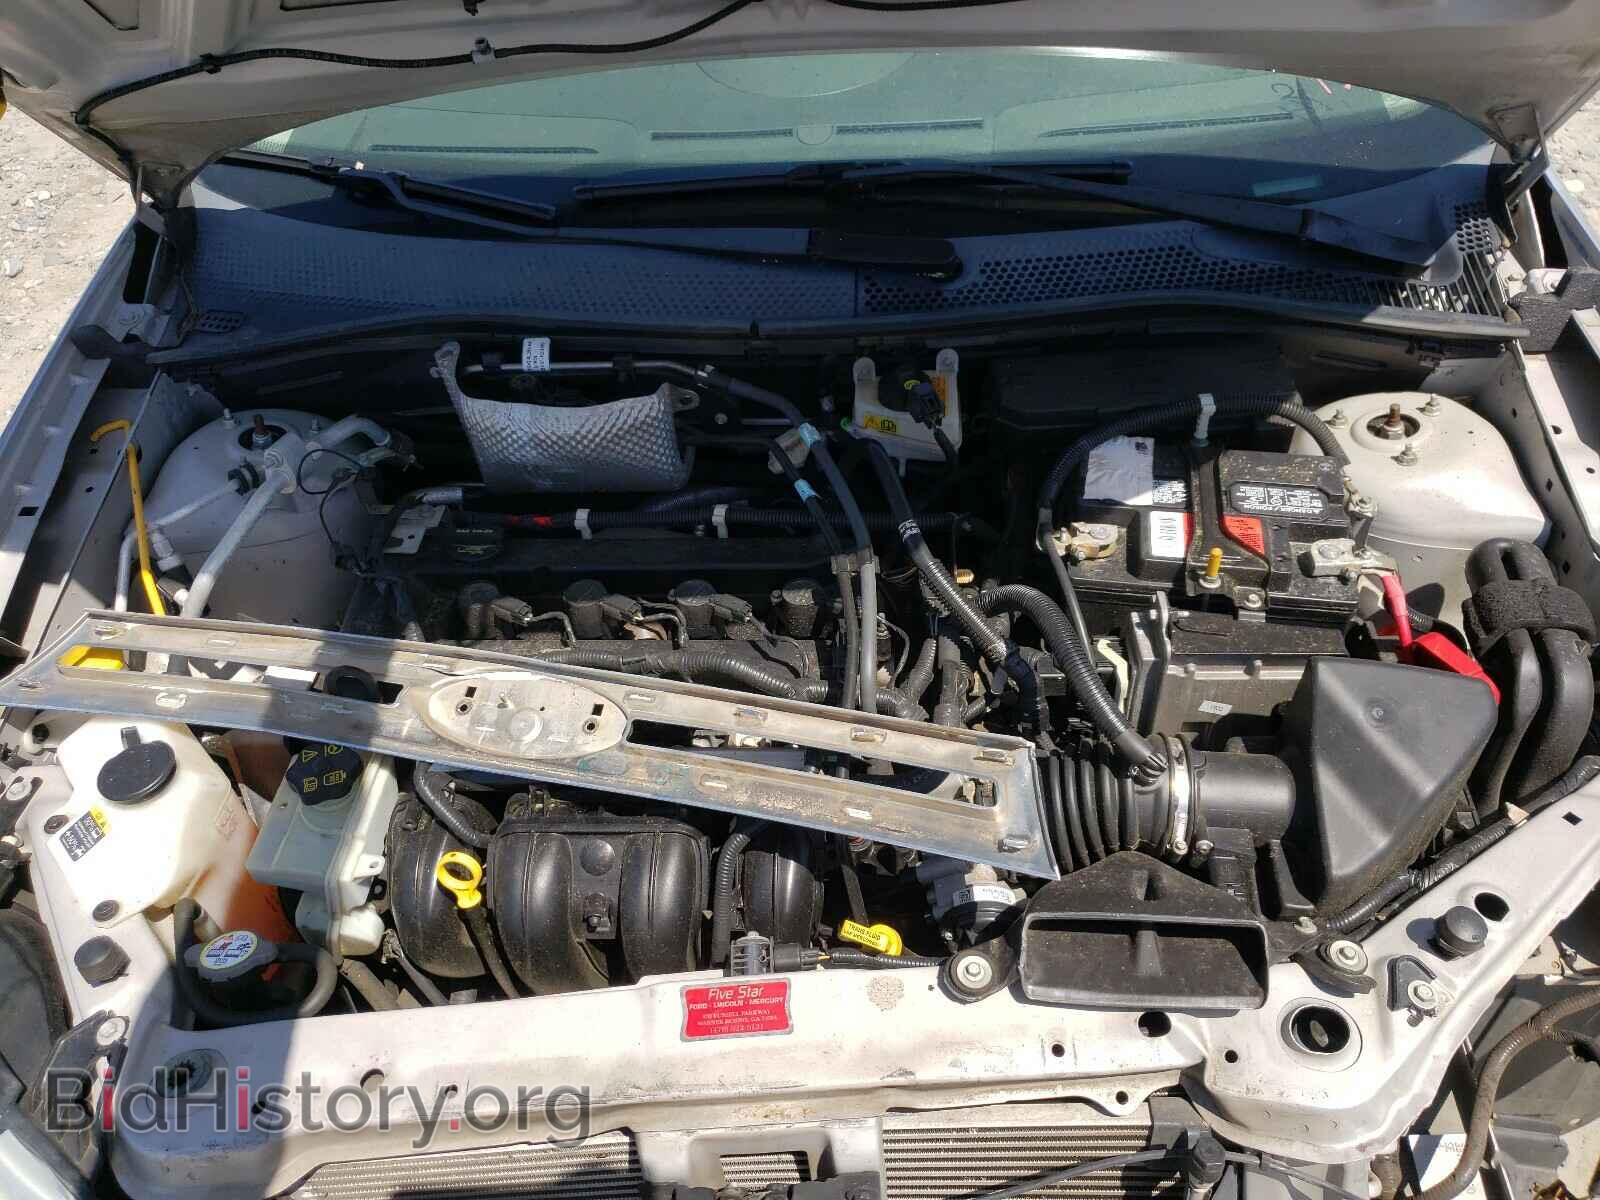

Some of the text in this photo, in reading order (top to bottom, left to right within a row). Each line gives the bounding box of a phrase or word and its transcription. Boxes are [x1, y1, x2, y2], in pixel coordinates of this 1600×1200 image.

[708, 985, 764, 1001] Five Star
[689, 997, 784, 1011] FORD LINCOLN MERCURY
